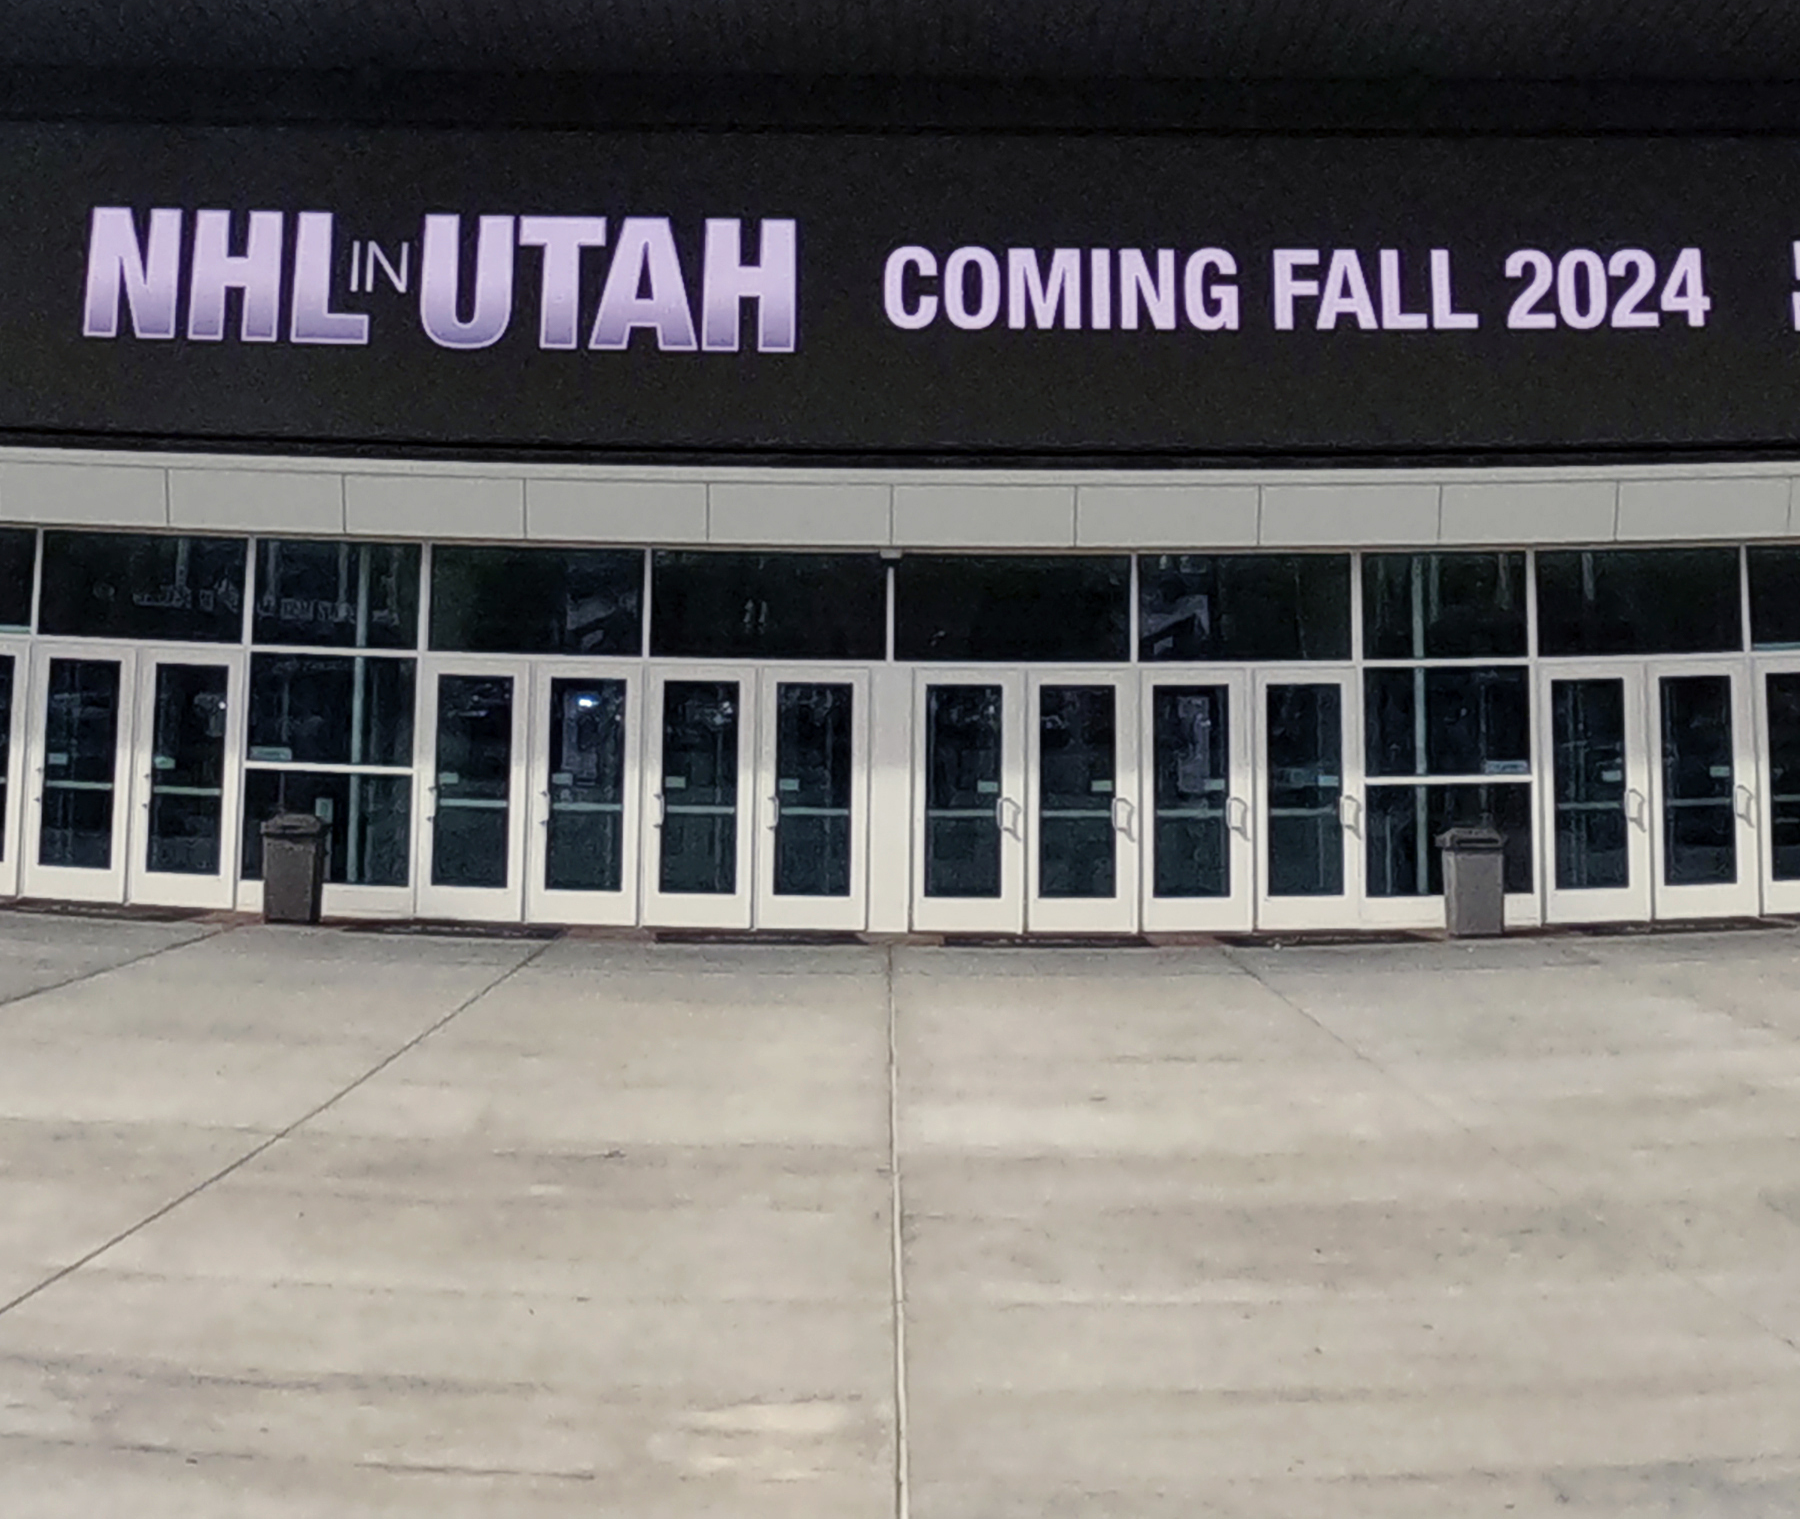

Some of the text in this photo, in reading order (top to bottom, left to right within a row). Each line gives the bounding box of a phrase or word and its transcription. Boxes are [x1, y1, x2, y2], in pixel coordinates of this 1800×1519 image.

[82, 206, 797, 353] NHL IN UTAH
[882, 246, 1712, 331] COMING FALL 2024
